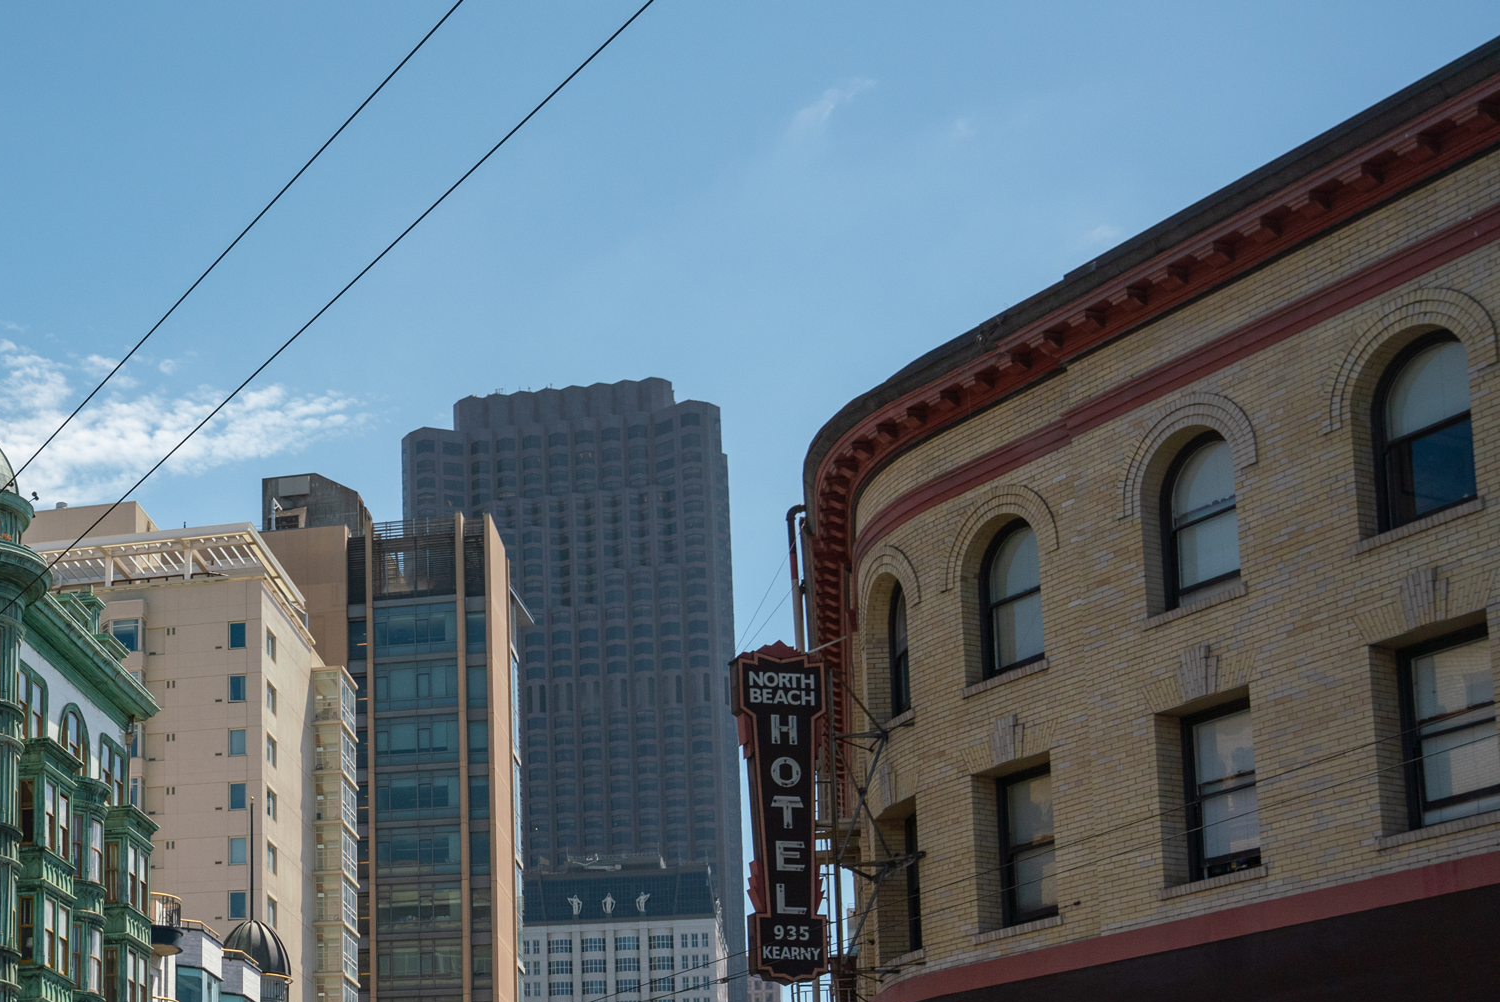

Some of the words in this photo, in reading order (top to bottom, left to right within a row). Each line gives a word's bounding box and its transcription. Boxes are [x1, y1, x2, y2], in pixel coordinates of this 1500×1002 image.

[748, 671, 815, 690] NORTH
[749, 688, 816, 706] BEACH
[769, 714, 808, 915] HOTEL
[773, 925, 810, 941] 935
[762, 945, 821, 962] KEARNY
